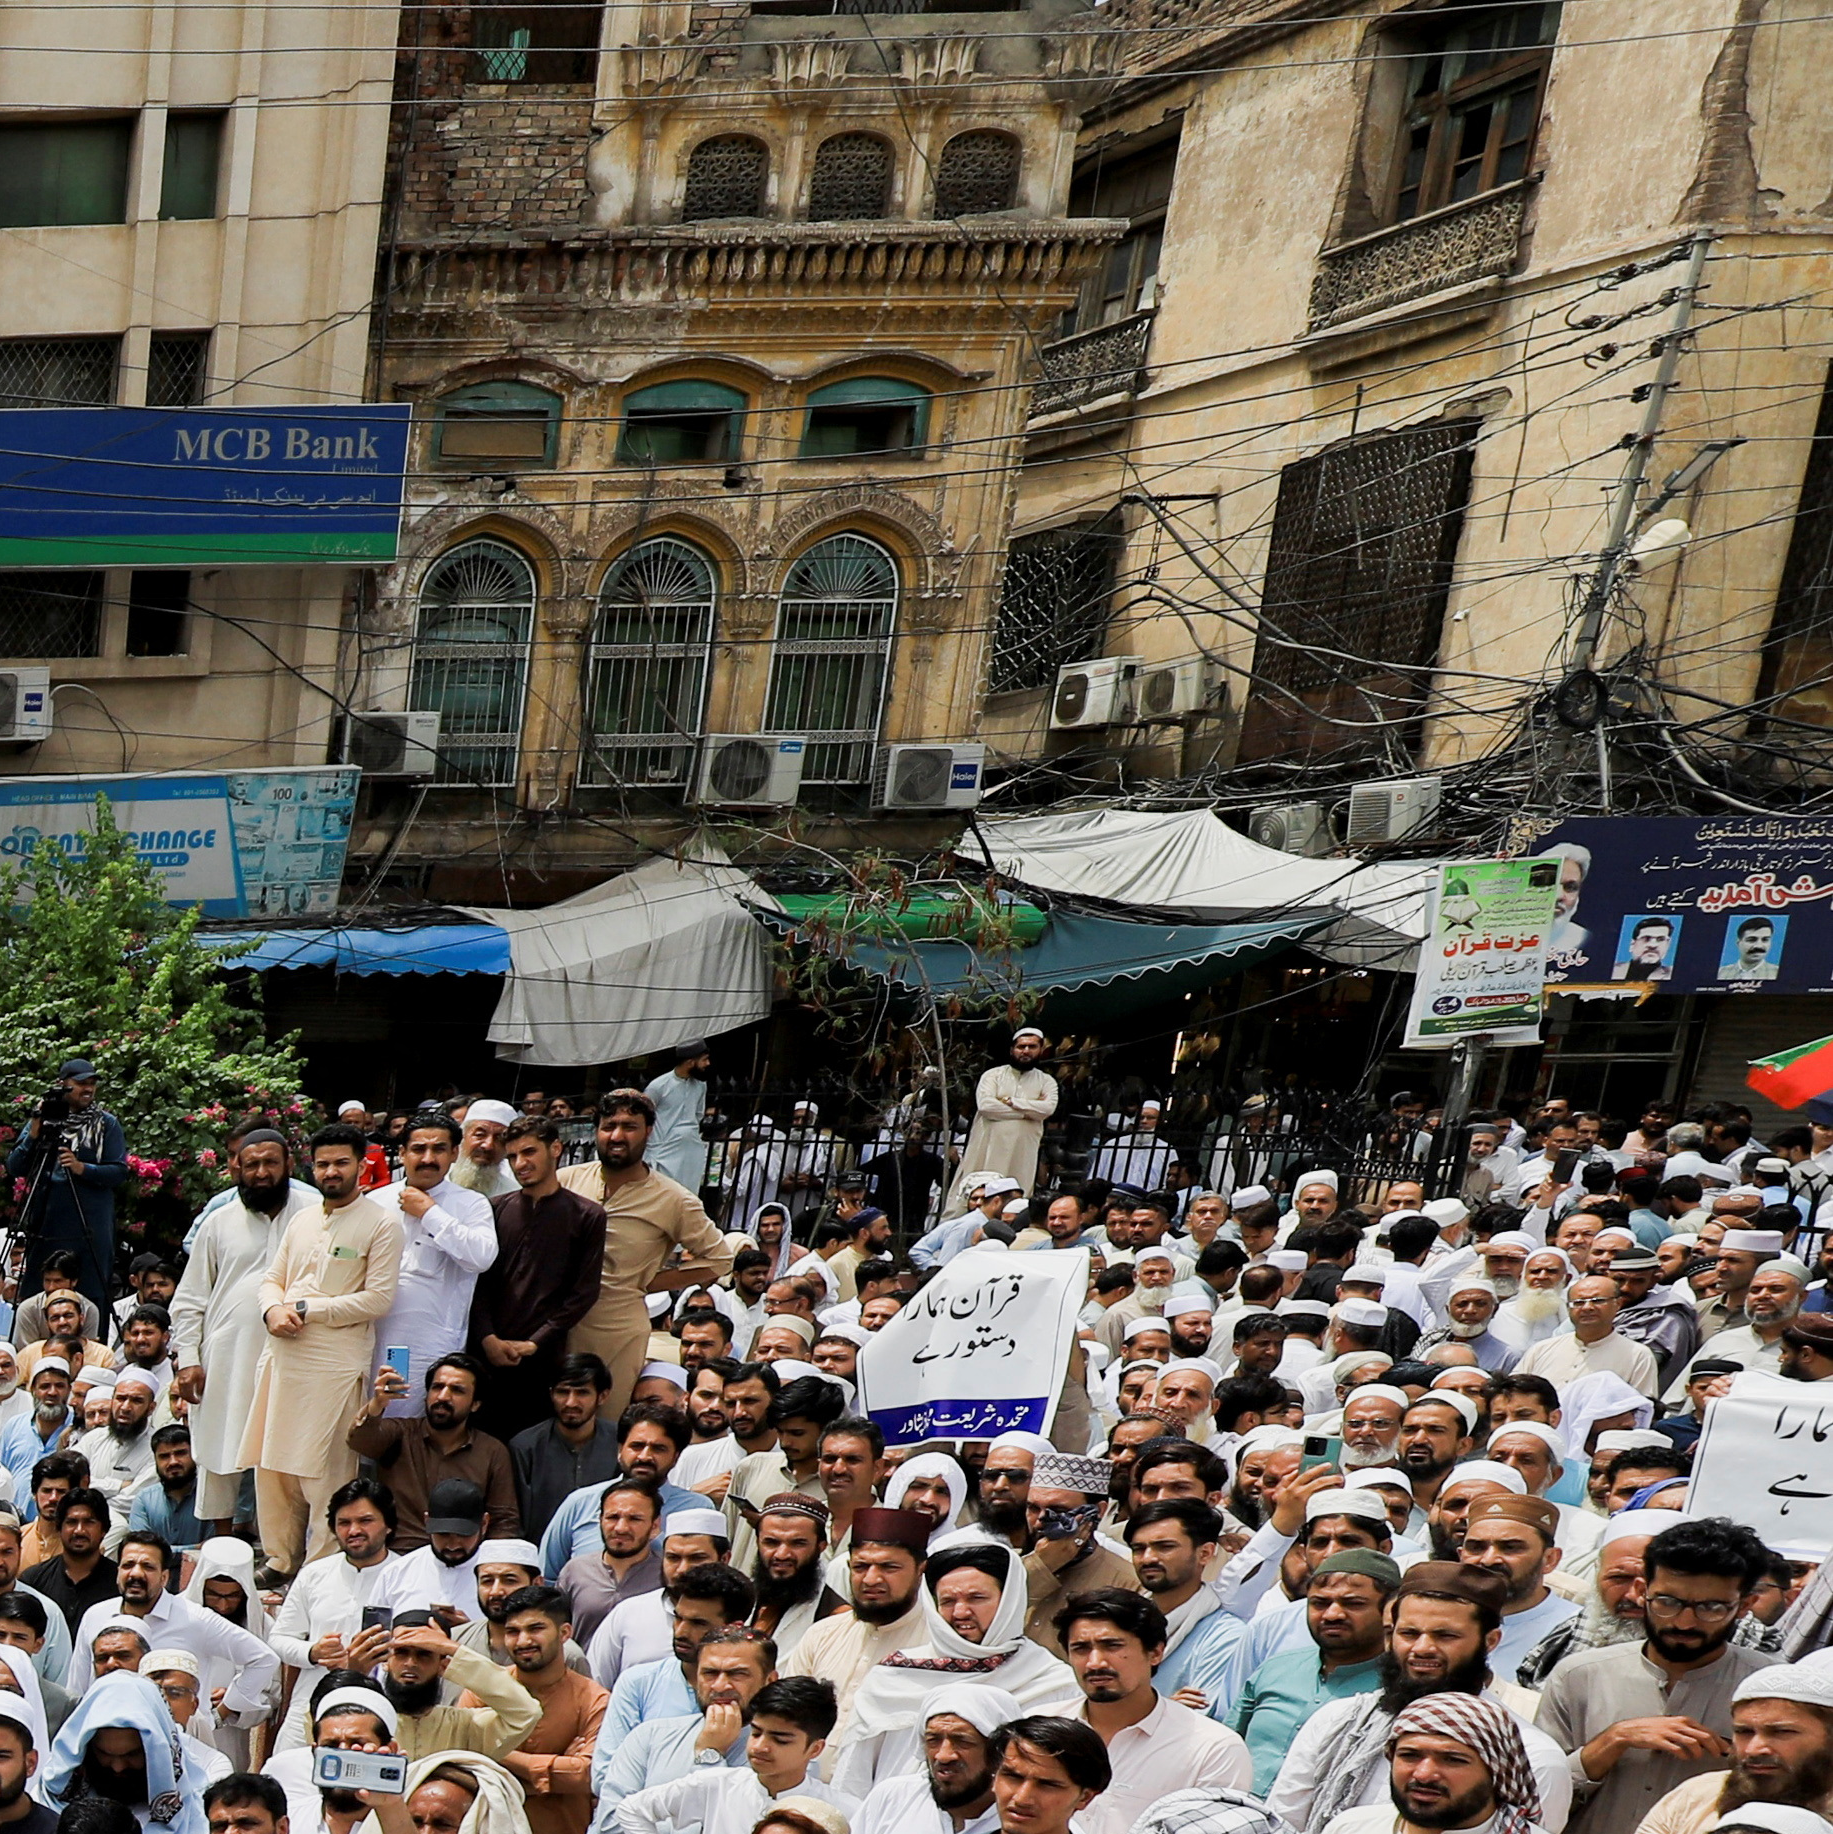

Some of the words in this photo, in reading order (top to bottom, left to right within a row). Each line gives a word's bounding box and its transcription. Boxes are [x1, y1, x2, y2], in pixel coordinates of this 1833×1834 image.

[172, 427, 271, 461] MCB
[283, 427, 380, 460] Bank
[23, 698, 42, 706] Haier
[950, 772, 976, 781] Haier
[271, 788, 293, 800] 100
[156, 855, 185, 865] Ltd.
[1649, 856, 1681, 870] آنے
[1677, 850, 1714, 869] شہر
[1710, 858, 1729, 870] اندر
[1646, 894, 1667, 909] ہیں
[1667, 887, 1696, 911] کہتے
[1443, 932, 1491, 957] قرآن
[903, 1290, 946, 1322] ہمارا
[950, 1274, 1024, 1321] قرآن
[944, 1327, 1017, 1359] دستور
[912, 1341, 942, 1378] ہے
[932, 1403, 997, 1433] شریعت
[996, 1405, 1030, 1428] متحدہ
[1774, 1405, 1833, 1443] مارا
